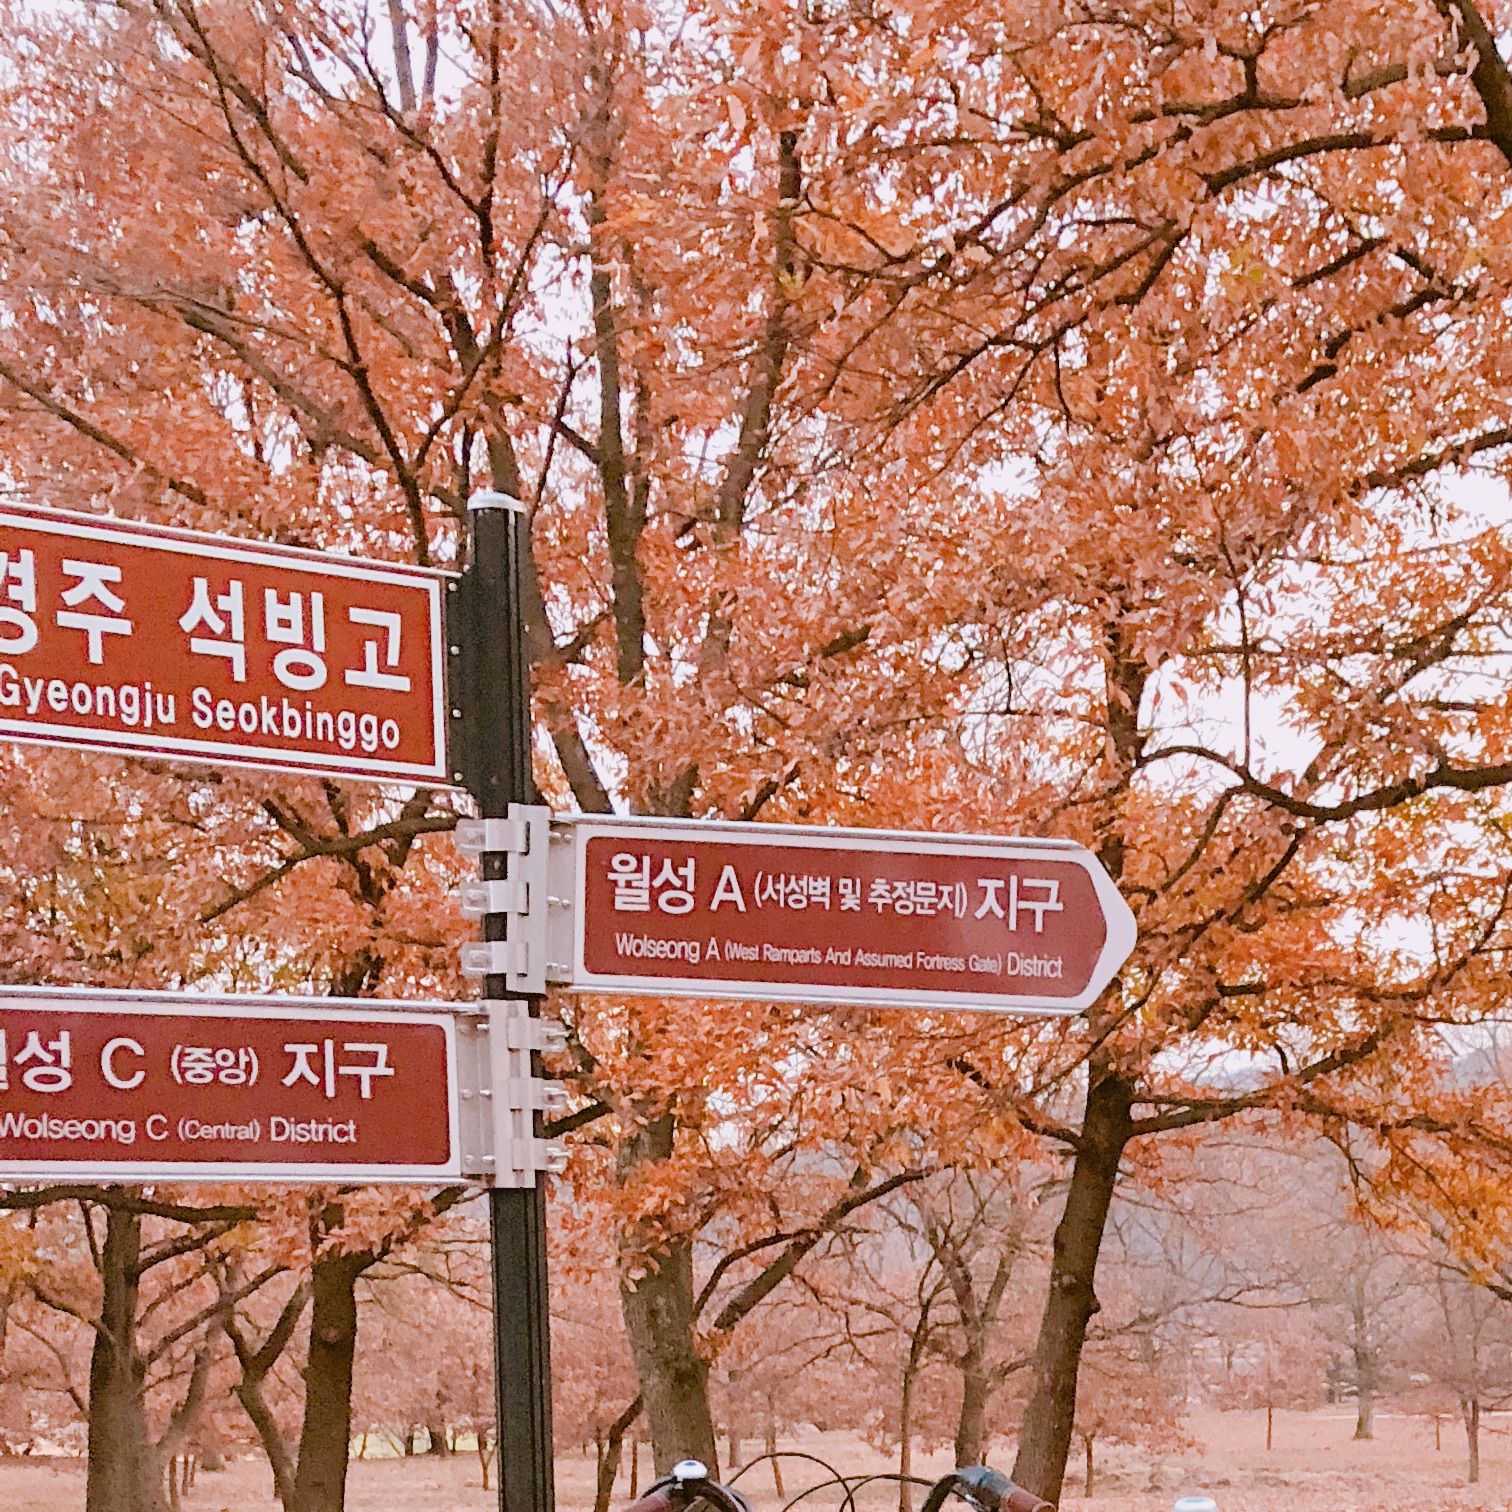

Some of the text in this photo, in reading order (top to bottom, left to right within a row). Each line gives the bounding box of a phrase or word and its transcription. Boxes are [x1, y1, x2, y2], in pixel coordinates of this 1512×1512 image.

[178, 577, 411, 691] 석빙고
[0, 663, 400, 752] Gyeongju Seokbinggo
[607, 853, 1064, 933] 월성 A (서성벽 및 추정문지) 지구
[615, 932, 1063, 979] Wolseong A (West Ramparts And Assumed Fortress Gate) District
[0, 1029, 395, 1099] 성 C (중앙) 지구
[0, 1112, 357, 1144] Wolseong C (Central) District
